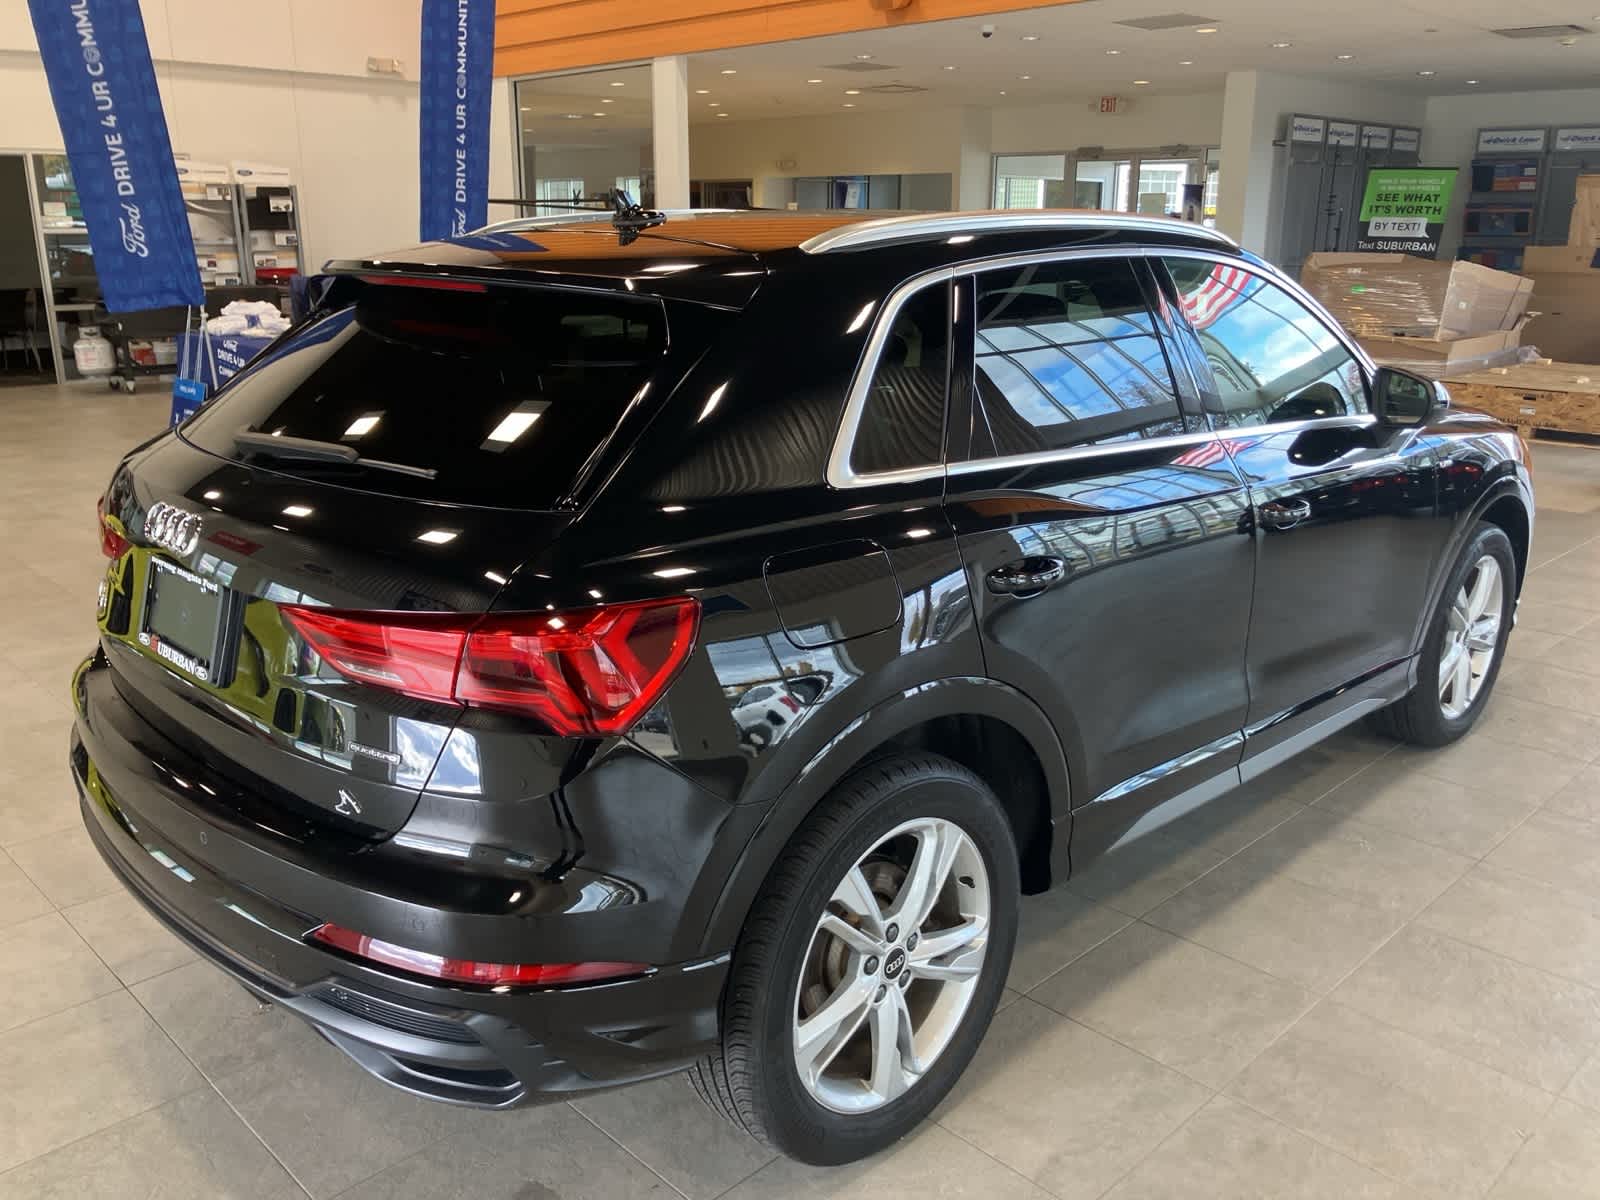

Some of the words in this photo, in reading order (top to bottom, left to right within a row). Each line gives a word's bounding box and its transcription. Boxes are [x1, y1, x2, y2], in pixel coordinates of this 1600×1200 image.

[92, 81, 113, 111] UR
[101, 114, 117, 128] 4
[455, 104, 467, 129] UR
[456, 133, 466, 145] 4
[104, 132, 135, 196] DRIVE
[455, 149, 467, 202] DRIVE
[1375, 193, 1400, 202] SEE
[1403, 193, 1441, 203] WHAT
[1369, 205, 1393, 215] IT'S
[1395, 205, 1443, 216] WORTH
[118, 203, 149, 258] Ford
[1374, 222, 1389, 231] BY
[1358, 240, 1375, 249] Text
[1376, 240, 1437, 252] SUBURBAN
[202, 578, 218, 593] Ford
[150, 633, 196, 675] SUBURBAN
[350, 743, 398, 764] quattro
